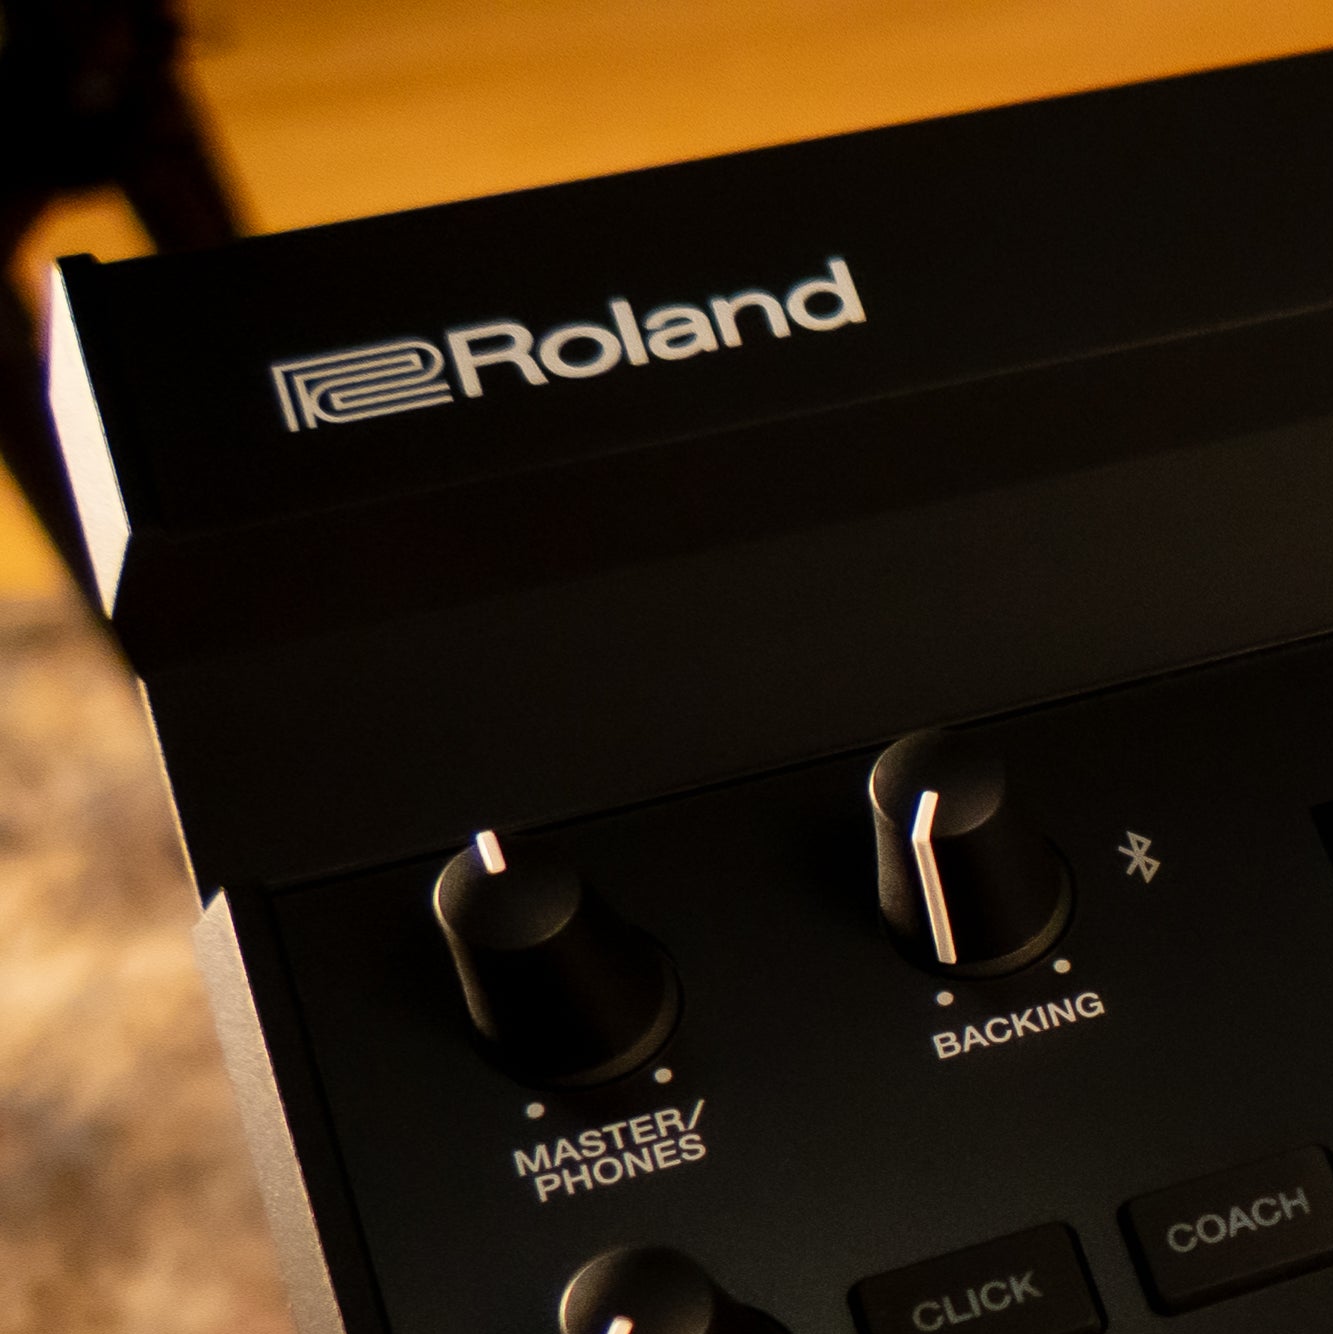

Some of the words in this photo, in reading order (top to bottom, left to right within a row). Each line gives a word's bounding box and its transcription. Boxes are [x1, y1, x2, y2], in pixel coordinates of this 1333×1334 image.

[449, 256, 868, 399] Roland
[931, 991, 1106, 1060] BACKING
[512, 1099, 705, 1176] MASTER/
[534, 1133, 706, 1202] PHONES
[1166, 1187, 1312, 1253] COACH
[911, 1271, 1043, 1333] CLICK
